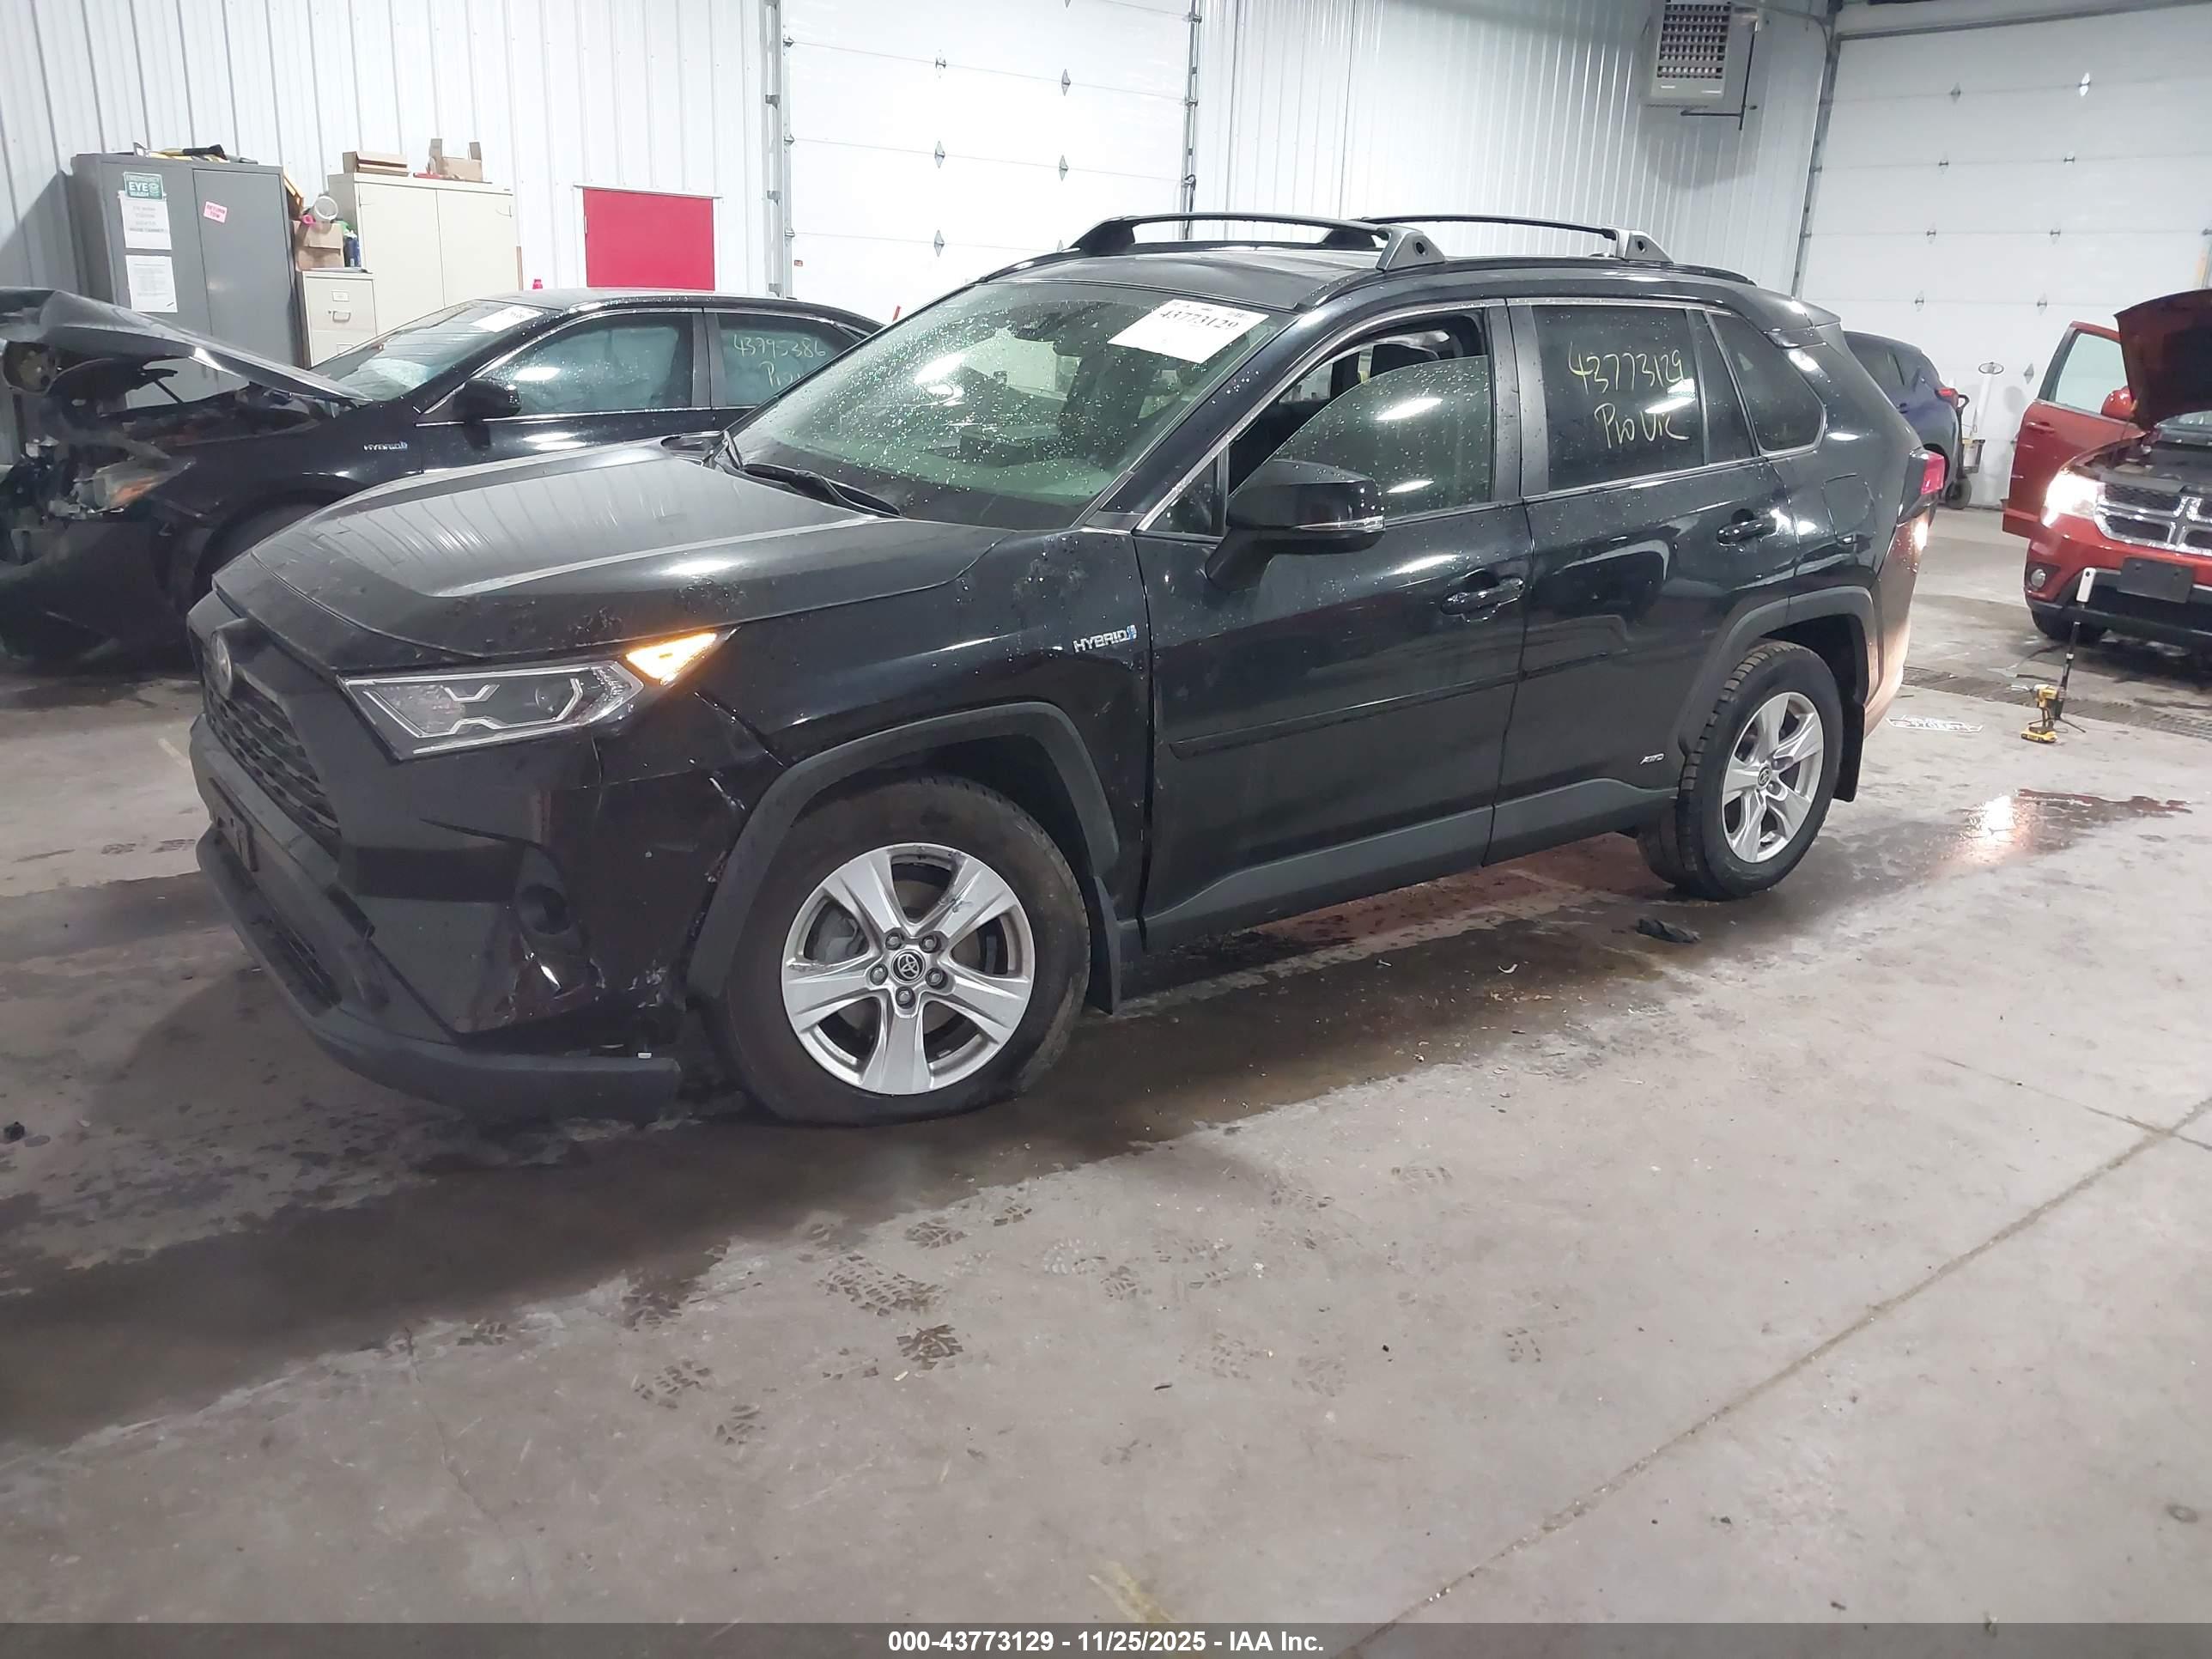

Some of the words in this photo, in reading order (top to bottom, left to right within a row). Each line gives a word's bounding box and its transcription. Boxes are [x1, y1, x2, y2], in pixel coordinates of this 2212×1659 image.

[128, 181, 149, 192] EYE
[1568, 341, 1686, 395] 43773129
[1073, 629, 1130, 653] HYBRID
